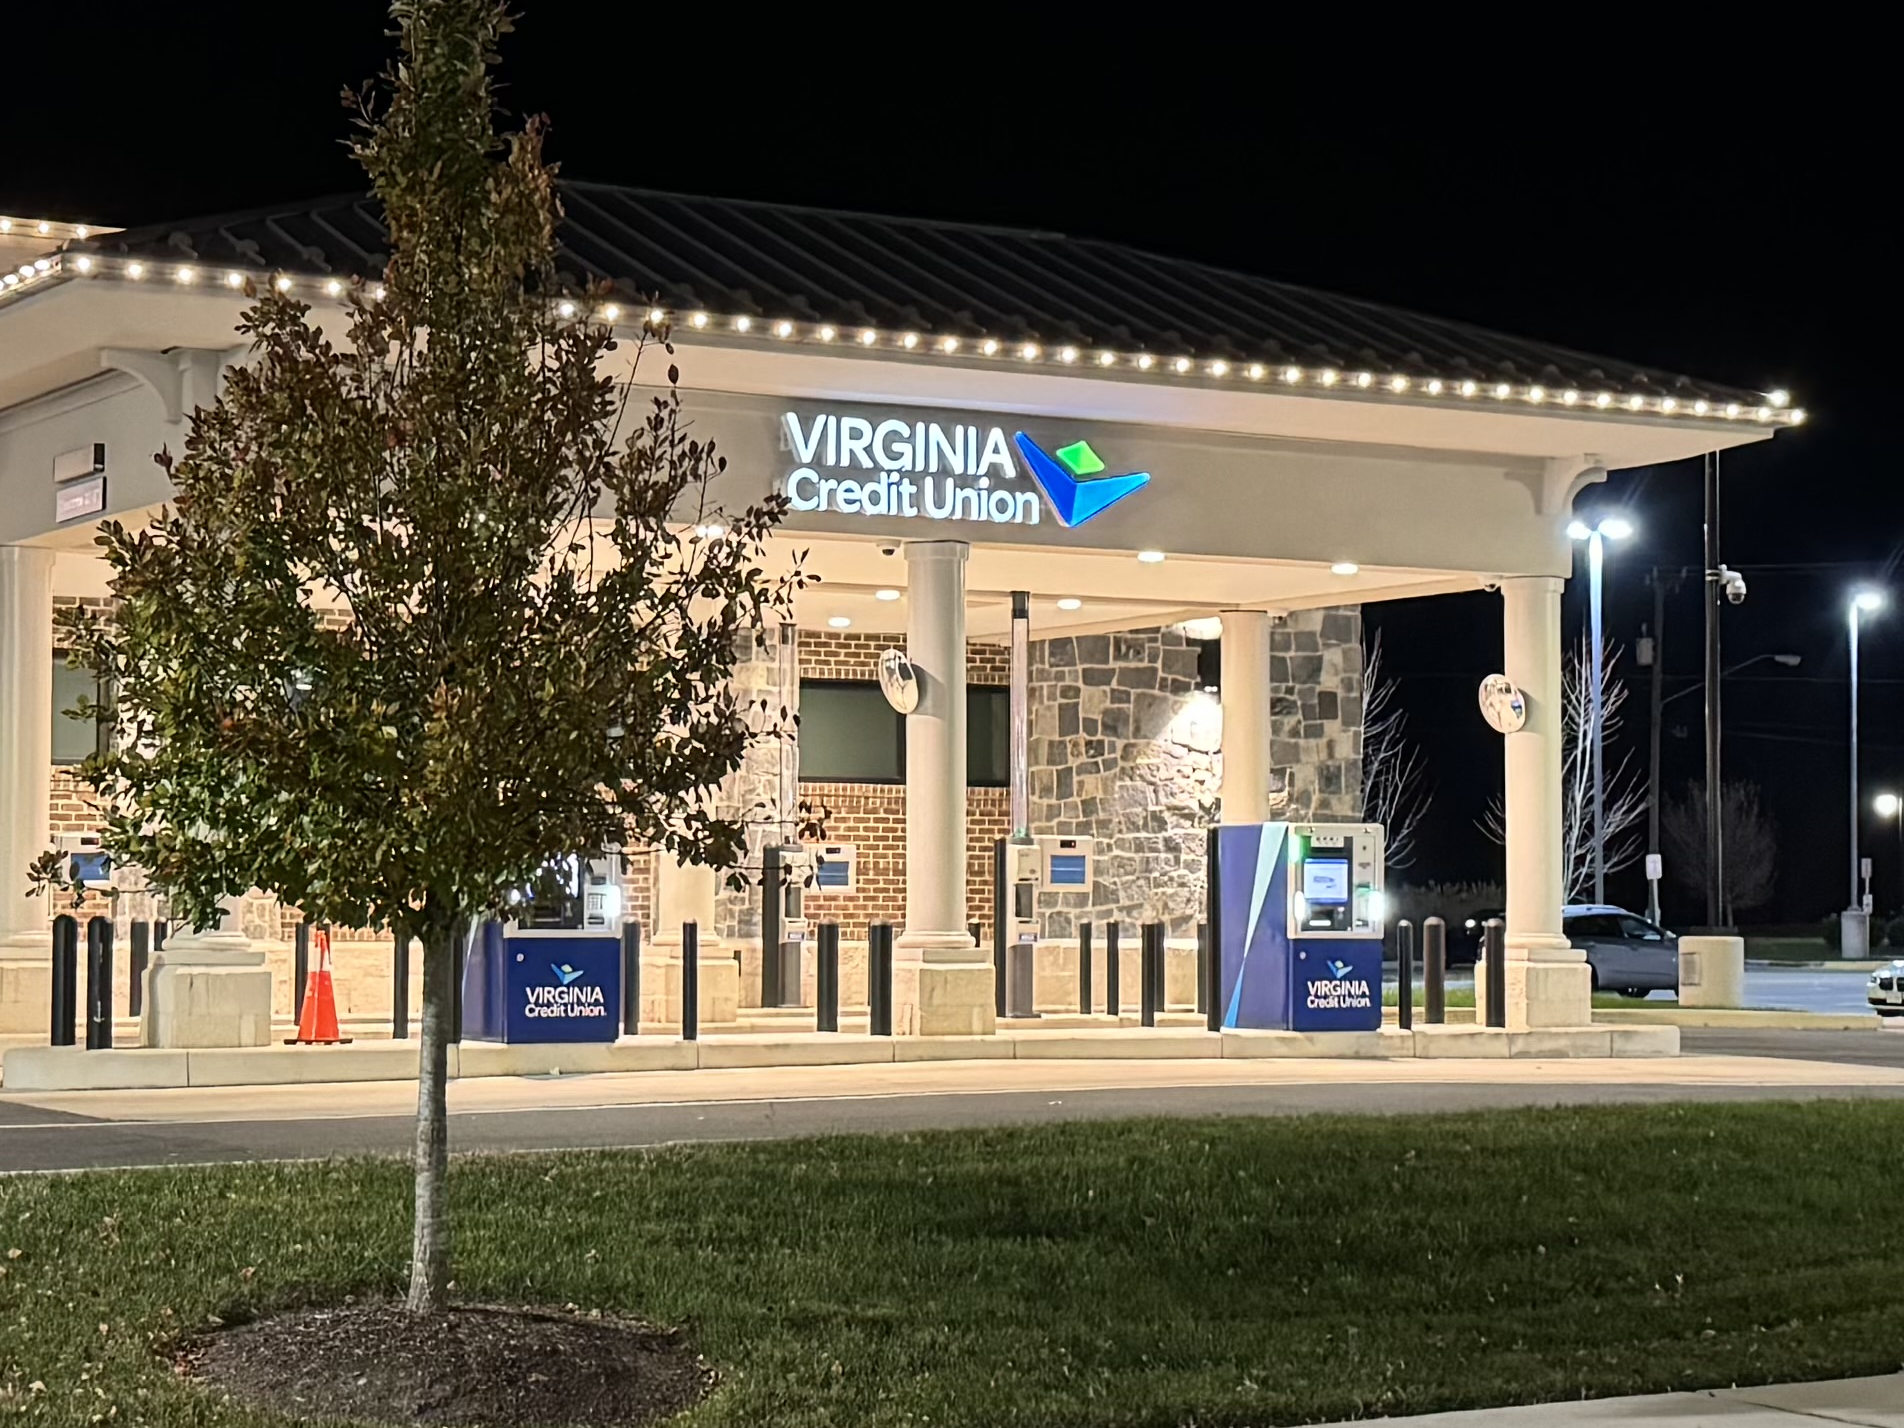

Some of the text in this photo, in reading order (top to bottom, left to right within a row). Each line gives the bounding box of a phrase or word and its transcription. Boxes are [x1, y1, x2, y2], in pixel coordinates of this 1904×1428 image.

[785, 411, 1016, 479] VIRGINIA
[787, 467, 1040, 525] Credit Union
[525, 986, 604, 1004] VIRGINIA
[1307, 980, 1369, 997] VIRGINIA
[1307, 995, 1371, 1008] Credit Union
[524, 1003, 605, 1018] Credit Union
